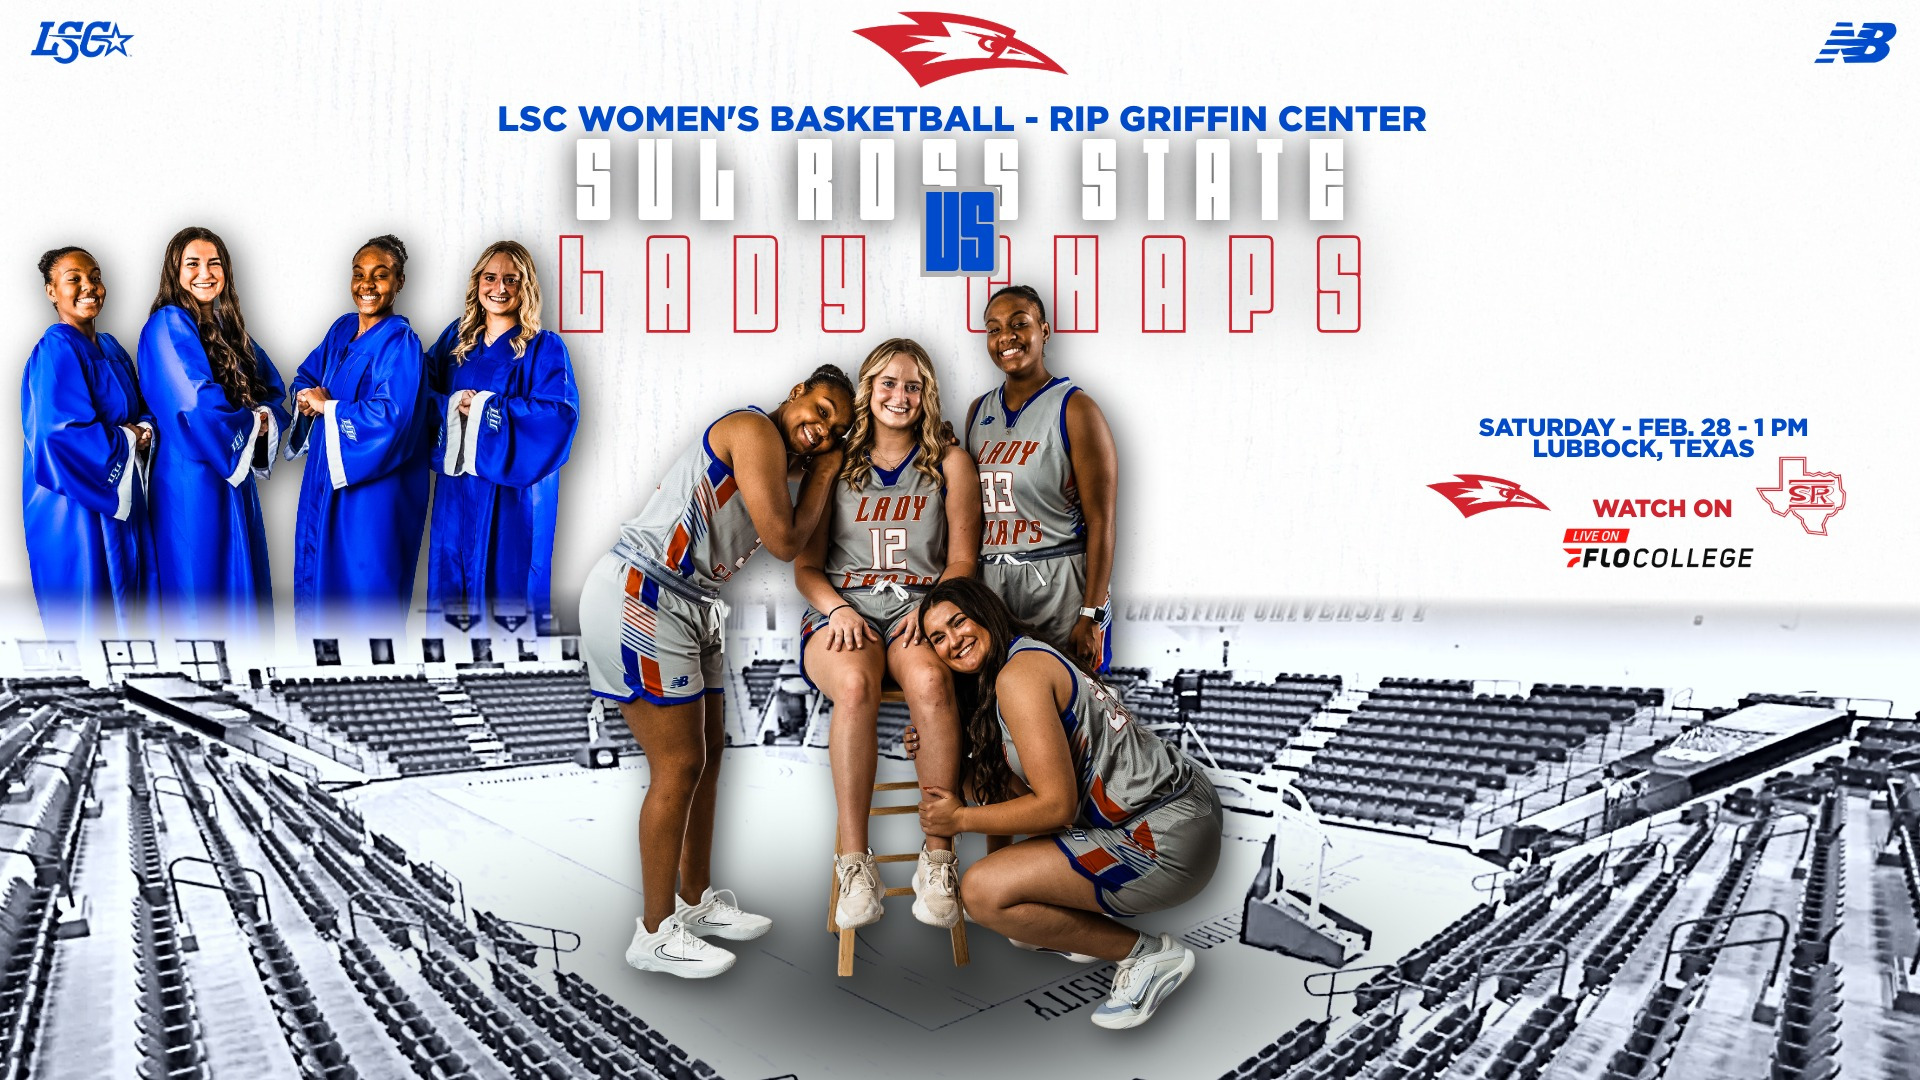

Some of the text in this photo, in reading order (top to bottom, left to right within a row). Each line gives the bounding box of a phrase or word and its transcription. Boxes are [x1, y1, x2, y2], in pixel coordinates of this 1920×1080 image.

[977, 440, 1041, 466] LADY
[980, 471, 1017, 514] 33
[854, 495, 930, 522] LADY
[983, 518, 1043, 546] HAPS
[868, 527, 909, 571] 12
